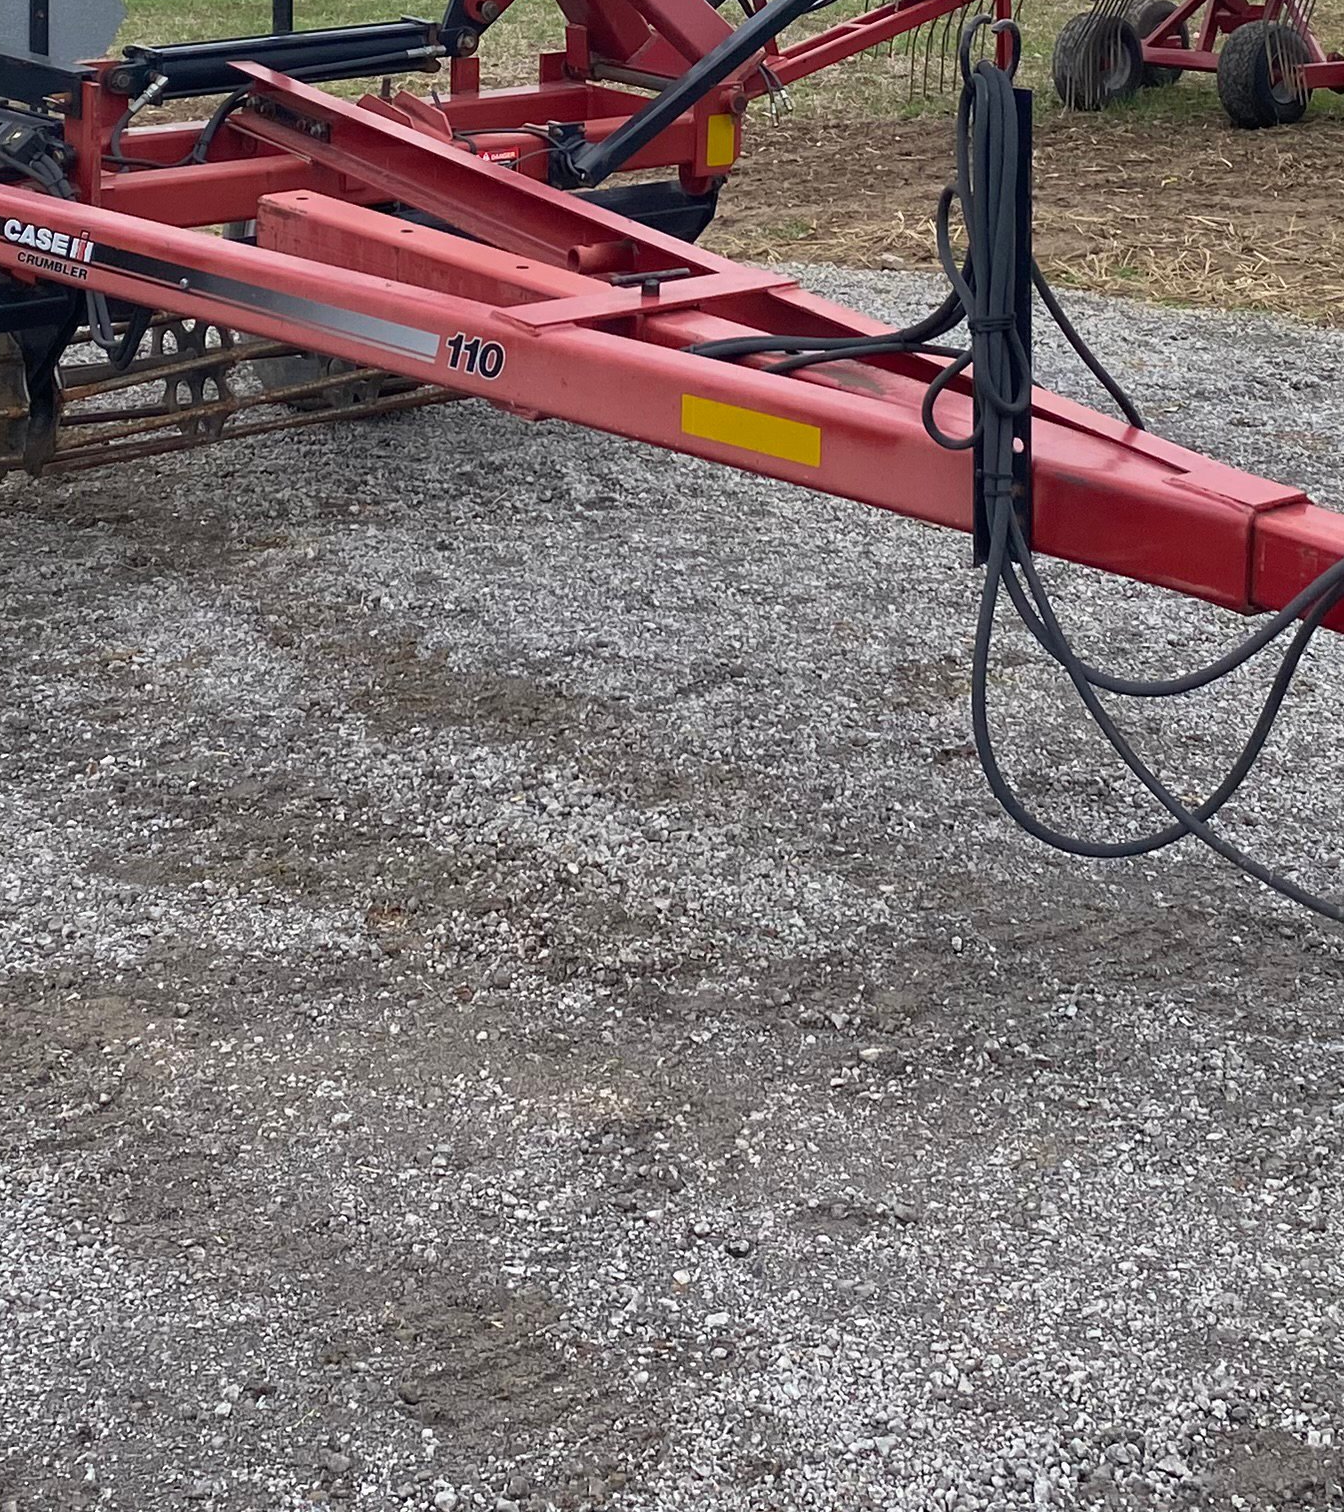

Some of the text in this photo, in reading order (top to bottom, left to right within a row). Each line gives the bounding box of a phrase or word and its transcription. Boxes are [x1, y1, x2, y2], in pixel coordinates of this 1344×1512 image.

[4, 218, 71, 257] CASE
[17, 251, 88, 280] CRUMBLER
[445, 331, 506, 381] 110
